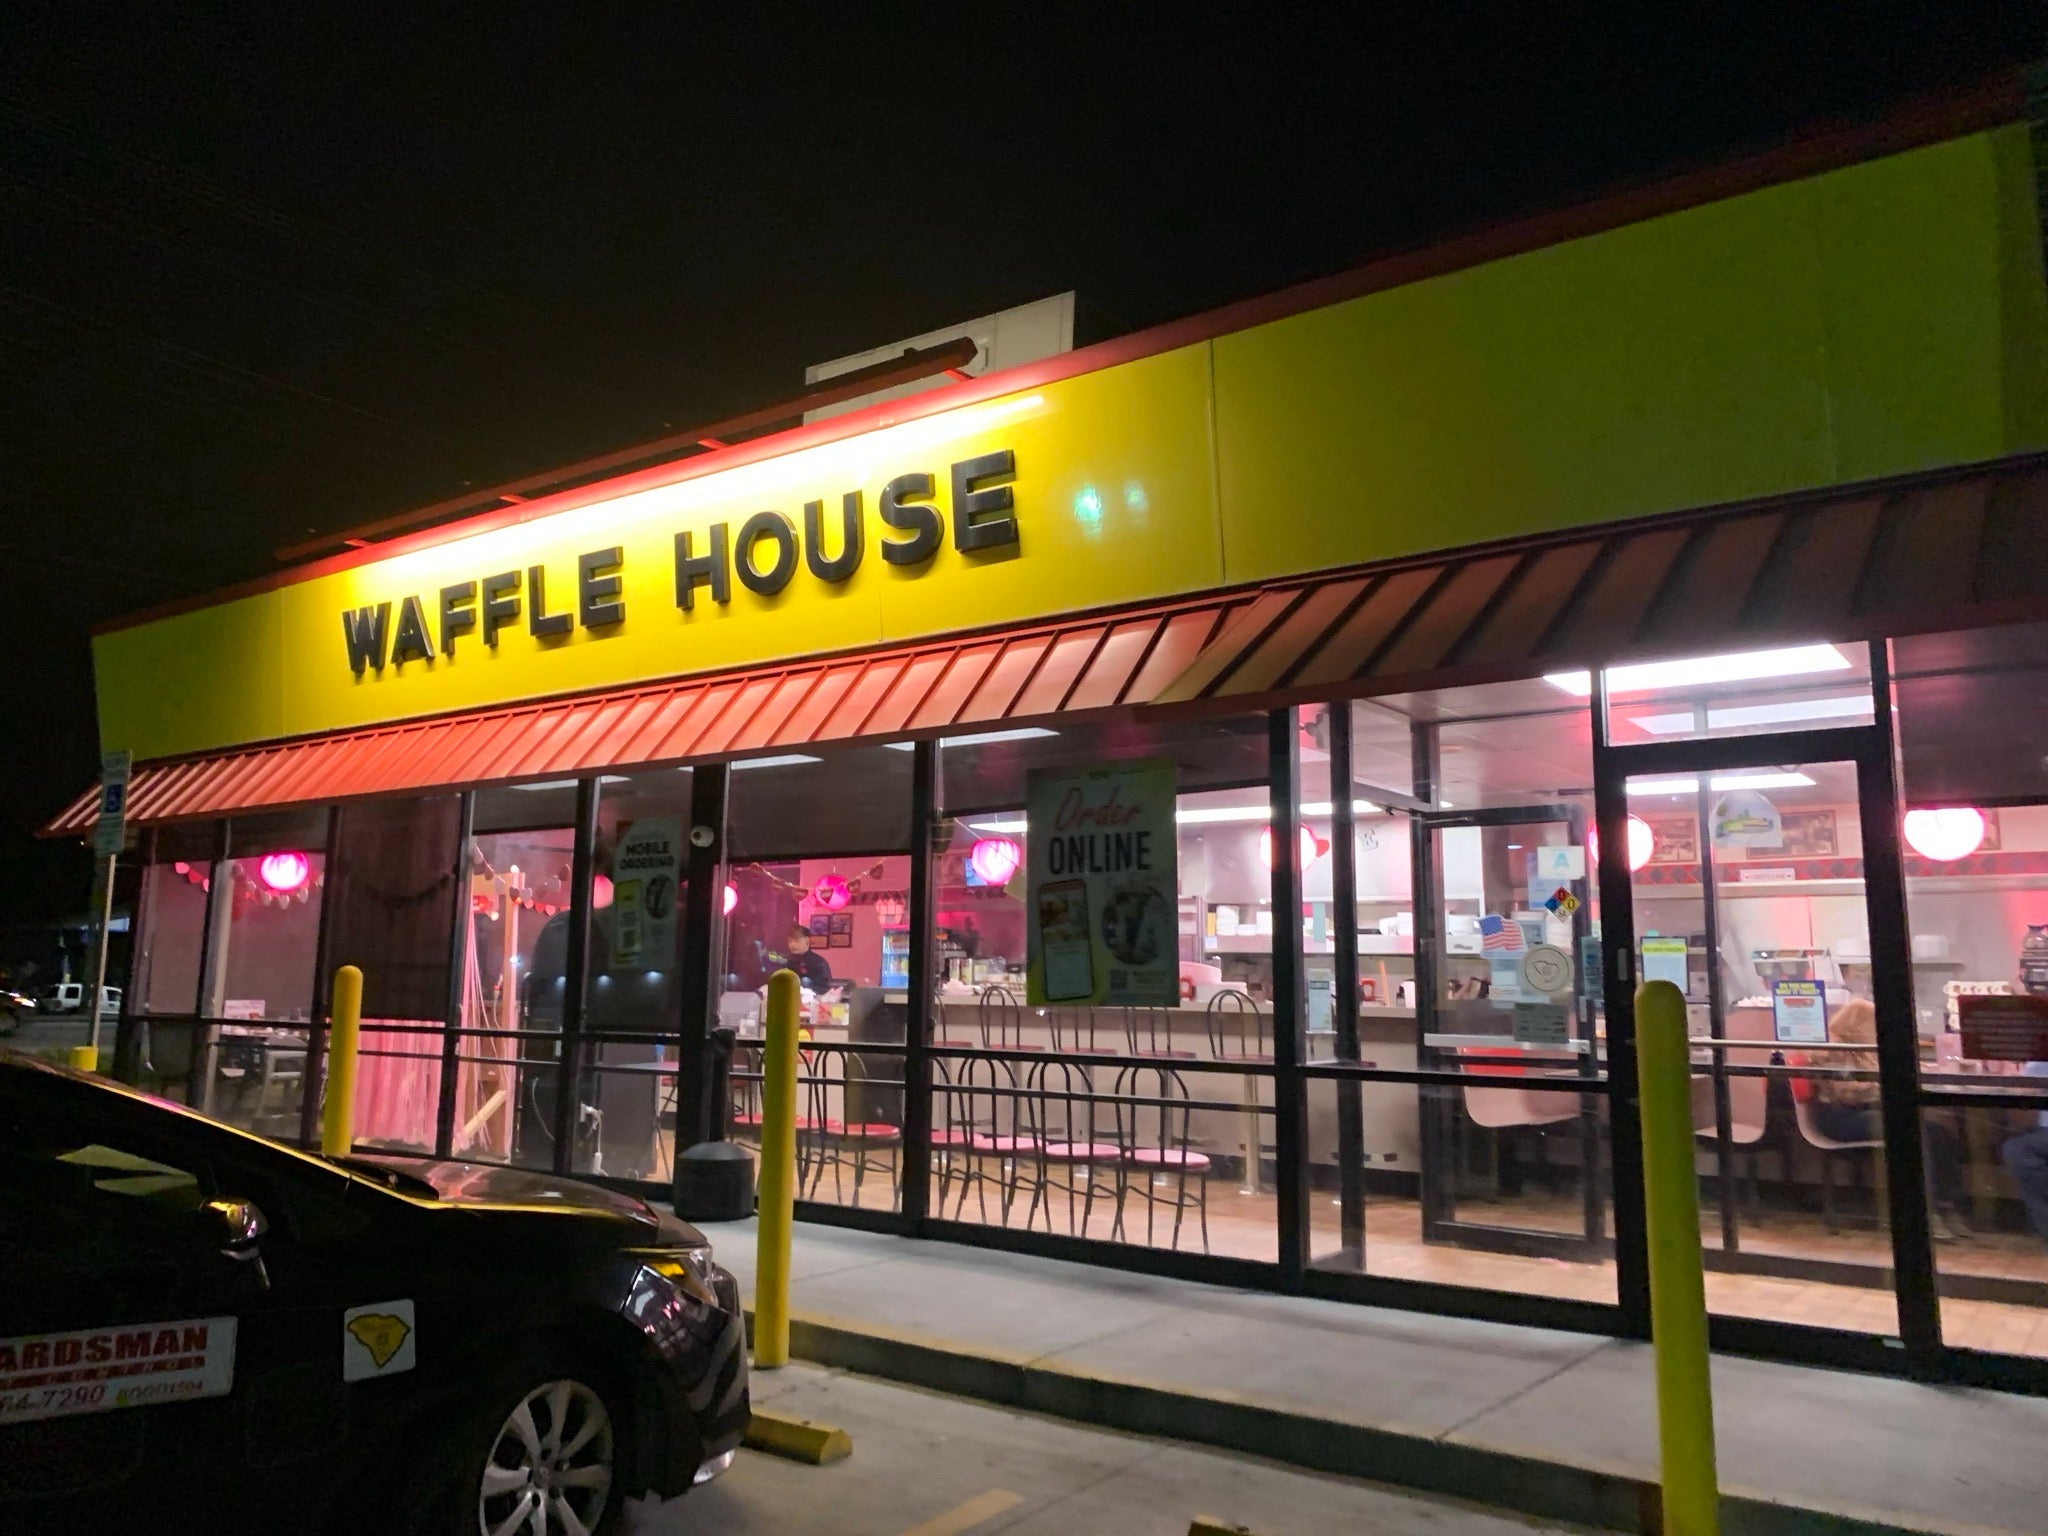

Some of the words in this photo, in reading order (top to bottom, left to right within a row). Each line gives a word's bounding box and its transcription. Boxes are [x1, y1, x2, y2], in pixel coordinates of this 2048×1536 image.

[342, 546, 626, 675] WAFFLE
[675, 449, 1020, 610] HOUSE
[1056, 786, 1144, 831] Order
[620, 856, 675, 870] ORDERING
[626, 841, 670, 856] MOBILE
[1049, 831, 1152, 875] ONLINE
[1553, 852, 1570, 868] A
